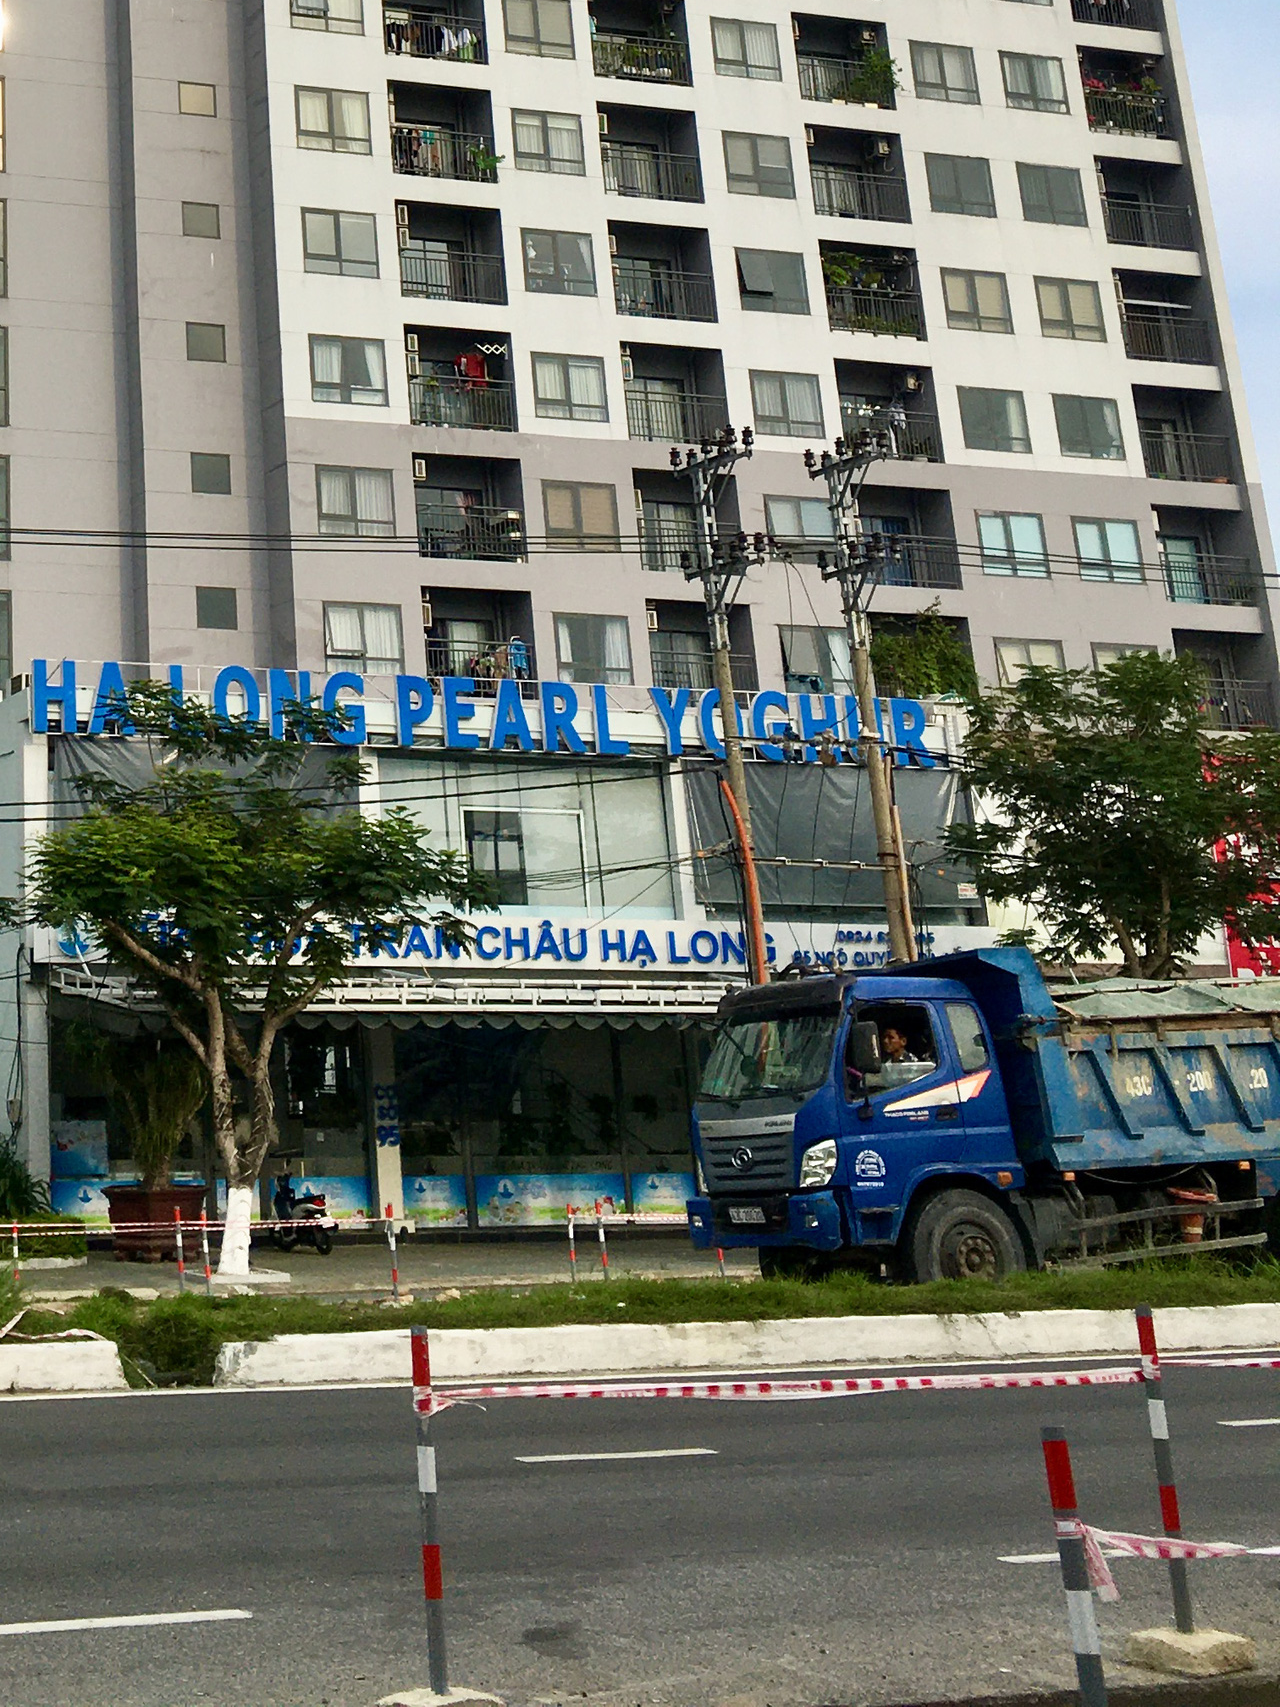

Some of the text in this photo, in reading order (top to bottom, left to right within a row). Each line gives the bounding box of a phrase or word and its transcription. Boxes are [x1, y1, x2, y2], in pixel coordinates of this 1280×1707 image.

[32, 659, 136, 734] HA
[169, 664, 366, 745] LONG
[395, 675, 630, 754] PEARL
[476, 920, 587, 961] CHÂU
[601, 929, 657, 968] HẠ
[1125, 1075, 1152, 1097] 43C
[1187, 1070, 1214, 1092] 200
[377, 1125, 400, 1147] 95
